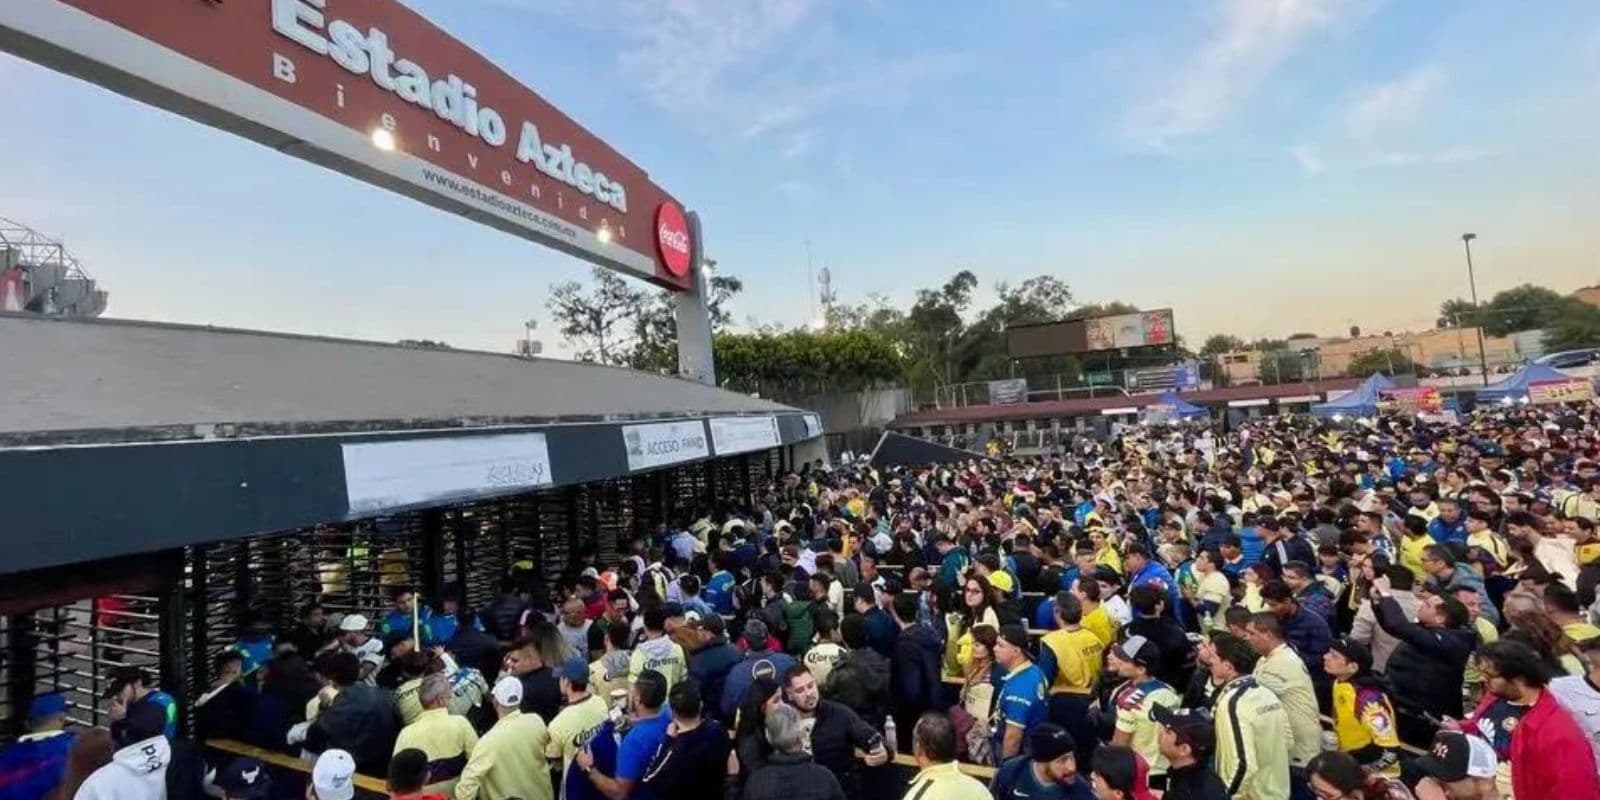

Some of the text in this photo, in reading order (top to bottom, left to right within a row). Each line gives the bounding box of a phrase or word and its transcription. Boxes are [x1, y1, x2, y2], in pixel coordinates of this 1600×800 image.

[271, 0, 628, 214] Estadio Azteca
[647, 439, 680, 455] ACCESO
